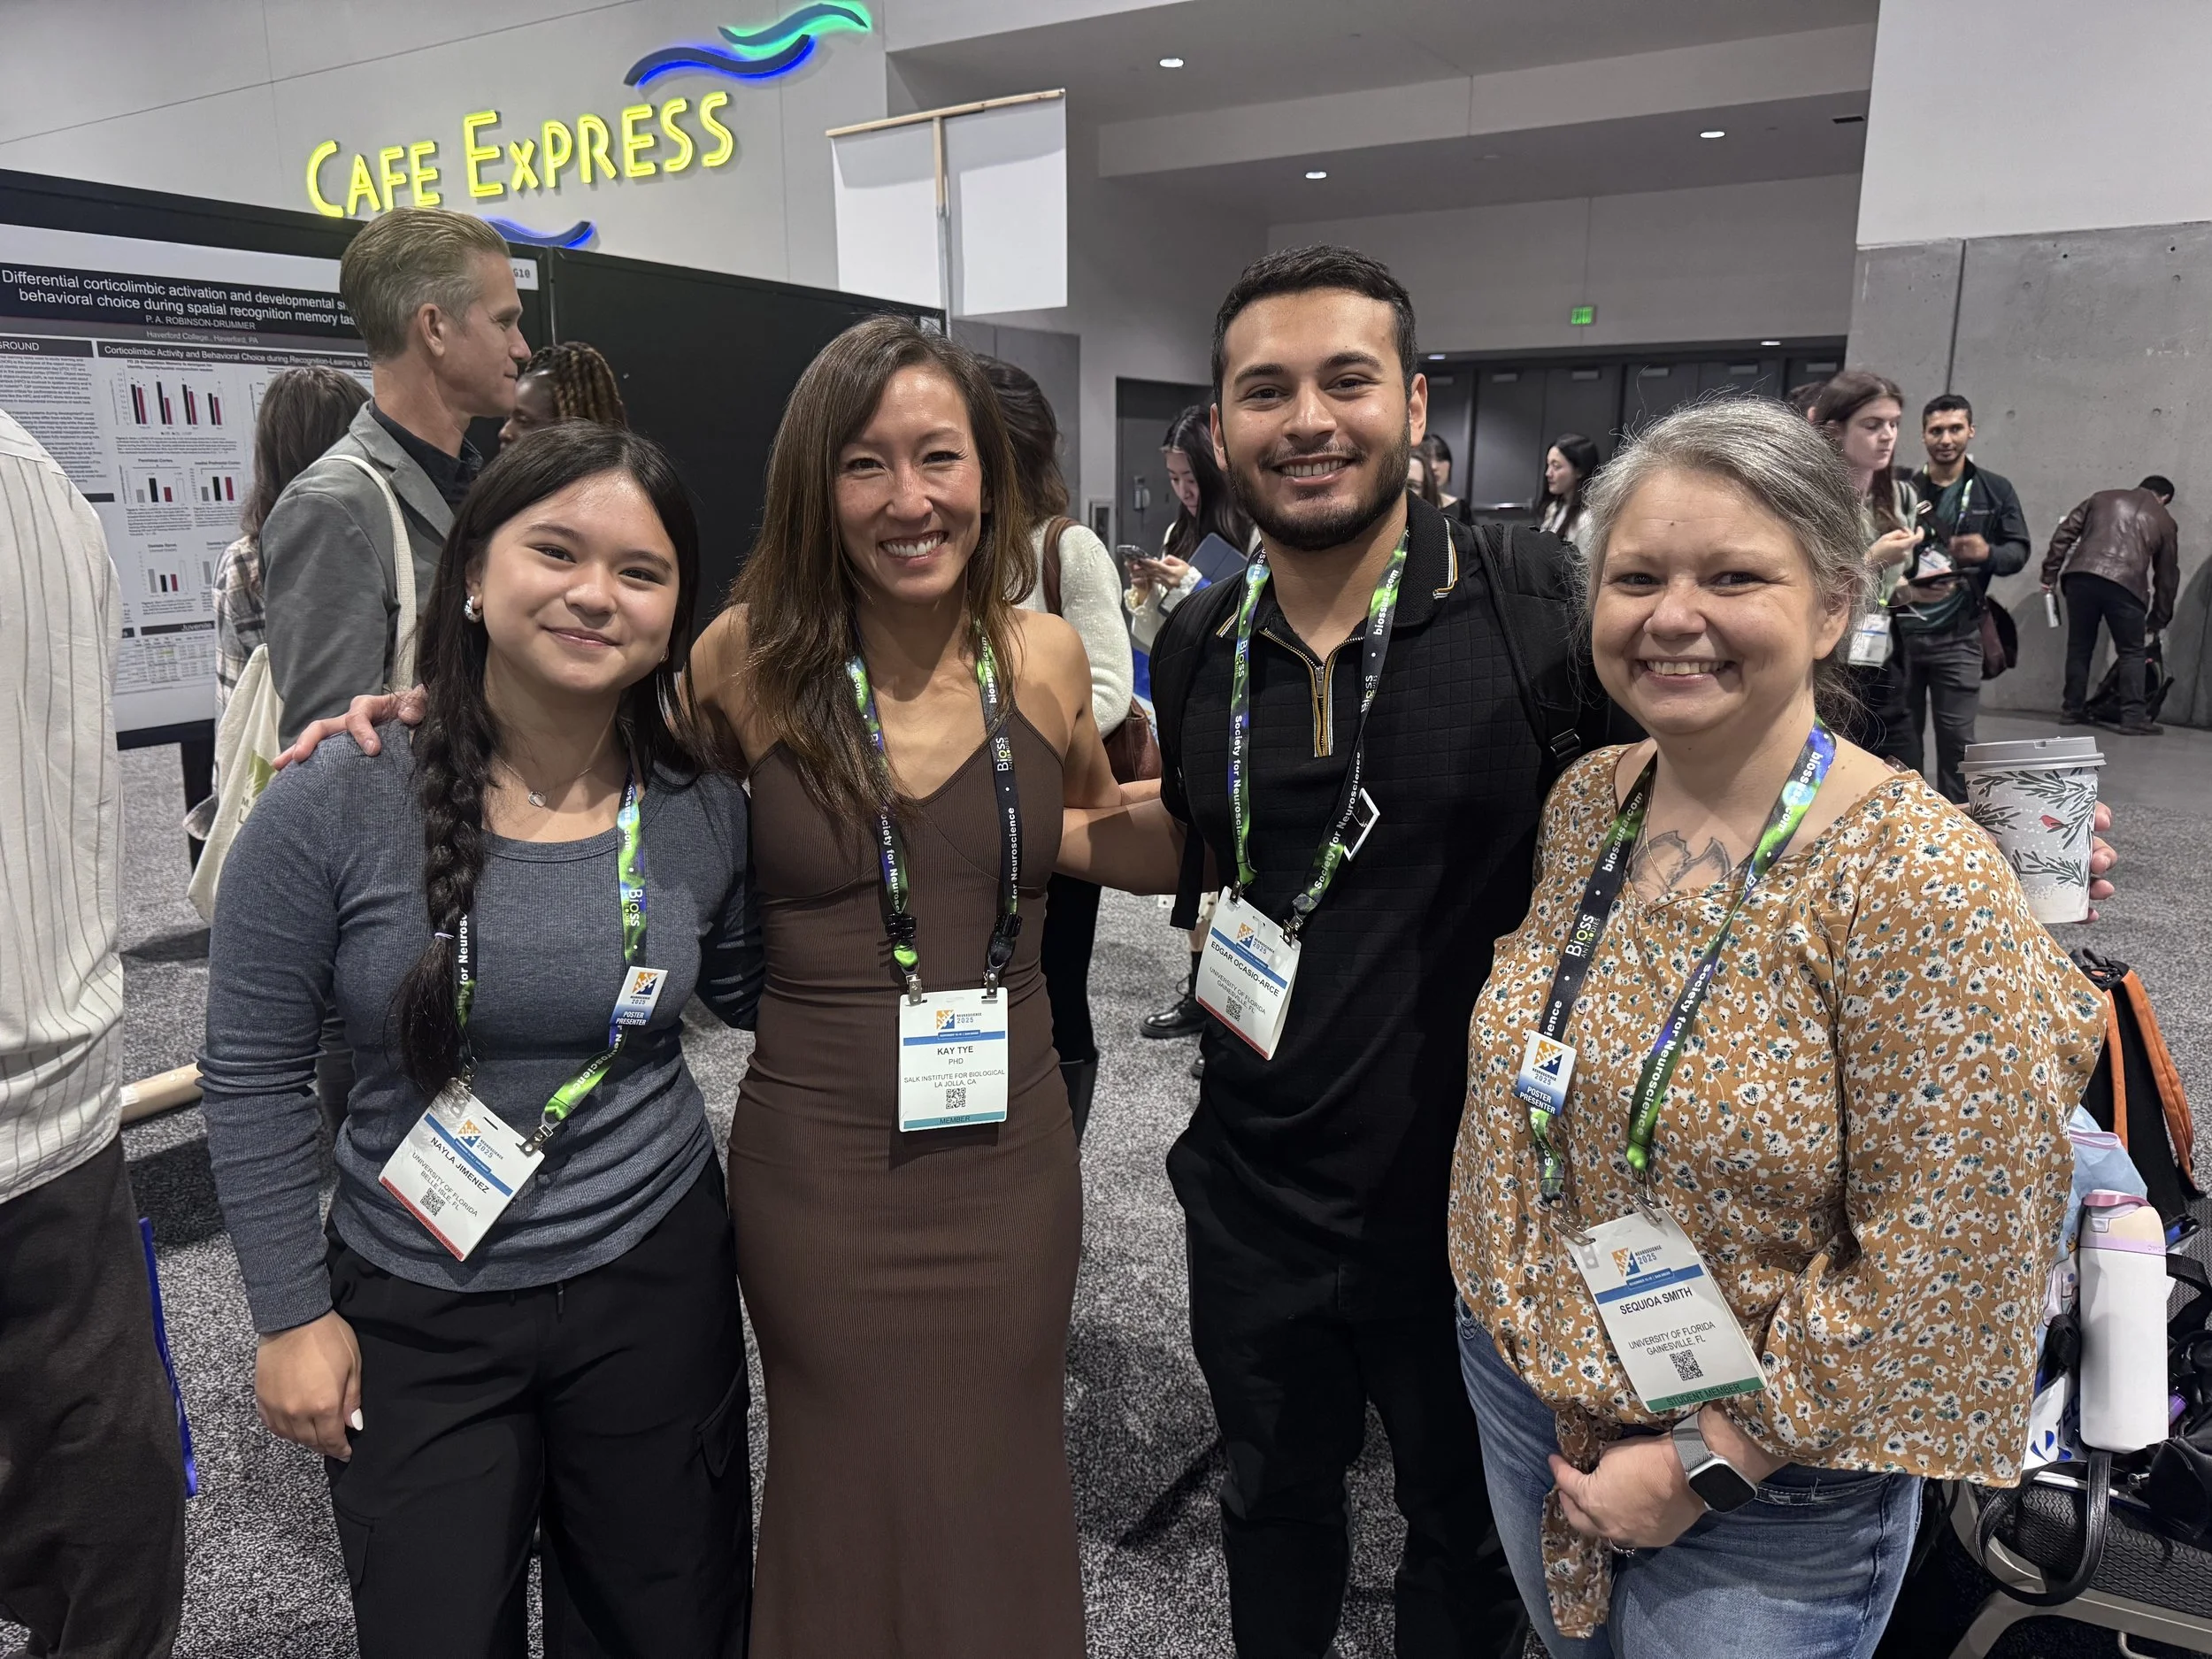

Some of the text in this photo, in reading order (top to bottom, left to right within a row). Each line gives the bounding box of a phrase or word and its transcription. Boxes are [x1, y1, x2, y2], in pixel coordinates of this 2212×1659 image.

[307, 140, 441, 218] CAFE
[2, 269, 80, 288] Differential
[83, 279, 166, 296] corticolimbic
[169, 285, 227, 301] activation
[229, 290, 252, 303] and
[255, 291, 335, 311] developmental
[19, 288, 357, 326] behavioral choice during spatial recognition memory tas
[145, 315, 257, 331] P. A. ROBINSON-DRUMMER
[146, 331, 181, 341] Haverford
[104, 345, 157, 357] Corticolimbic
[157, 349, 184, 359] Activity
[201, 351, 241, 361] Behavioral
[241, 353, 265, 362] Choice
[266, 354, 288, 365] during
[289, 355, 356, 368] Recognition-Learning
[1232, 715, 1243, 757] Society
[1233, 758, 1241, 776] for
[1314, 751, 1361, 890] Society for Neuroscience
[1601, 792, 1643, 873] biossusa.com
[1008, 807, 1018, 882] Neuroscience
[887, 849, 895, 865] for
[458, 911, 469, 964] Neuros
[1253, 941, 1267, 955] 2025
[460, 967, 469, 986] for
[1210, 941, 1233, 964] EDGAR
[1233, 958, 1280, 997] OCASIO-ARCE
[1210, 966, 1266, 1015] UNIVERSITY OF FLORIDA
[1248, 1005, 1256, 1015] FL
[937, 1045, 974, 1056] KAY TYE
[1636, 964, 1712, 1136] Society for Neuroscience
[921, 1073, 953, 1082] INSTITUTE
[969, 1069, 1005, 1078] BIOLOGICAL
[1534, 1073, 1552, 1086] 2025
[1519, 1092, 1555, 1115] PRESENTER
[1526, 1086, 1552, 1104] POSTER
[939, 1115, 971, 1125] MEMBER
[476, 1141, 494, 1159] 2025
[430, 1136, 456, 1164] NAYLA
[455, 1163, 490, 1194] JIMENEZ
[411, 1152, 445, 1187] UNIVERSITY
[444, 1183, 454, 1194] OF
[452, 1191, 479, 1217] FLORIDA
[420, 1170, 439, 1189] BELLE
[451, 1201, 460, 1211] FL
[1637, 1252, 1657, 1265] 2025
[1619, 1286, 1694, 1315] SEQUIOA SMITH
[1628, 1321, 1716, 1349] UNIVERSITY OF FLORIDA
[1647, 1334, 1707, 1356] GAINESVILLE, FL
[1666, 1383, 1741, 1407] STUDENT MEMBER
